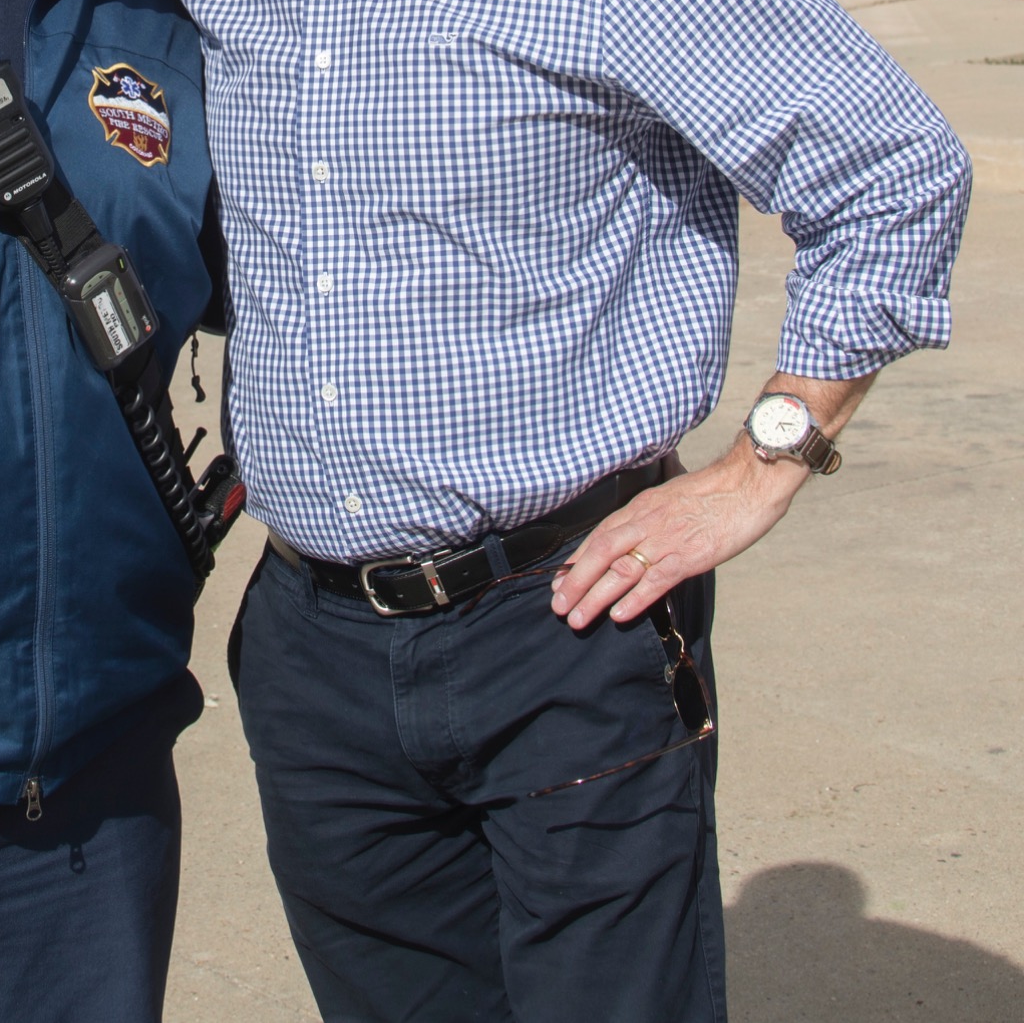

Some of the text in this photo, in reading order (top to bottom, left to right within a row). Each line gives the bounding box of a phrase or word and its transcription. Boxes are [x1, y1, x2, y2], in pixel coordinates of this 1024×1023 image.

[99, 108, 168, 138] SOUTH METRO
[109, 117, 163, 142] FIRE RESCUE
[13, 172, 47, 195] MOTOROLA
[108, 325, 124, 351] SOUTH
